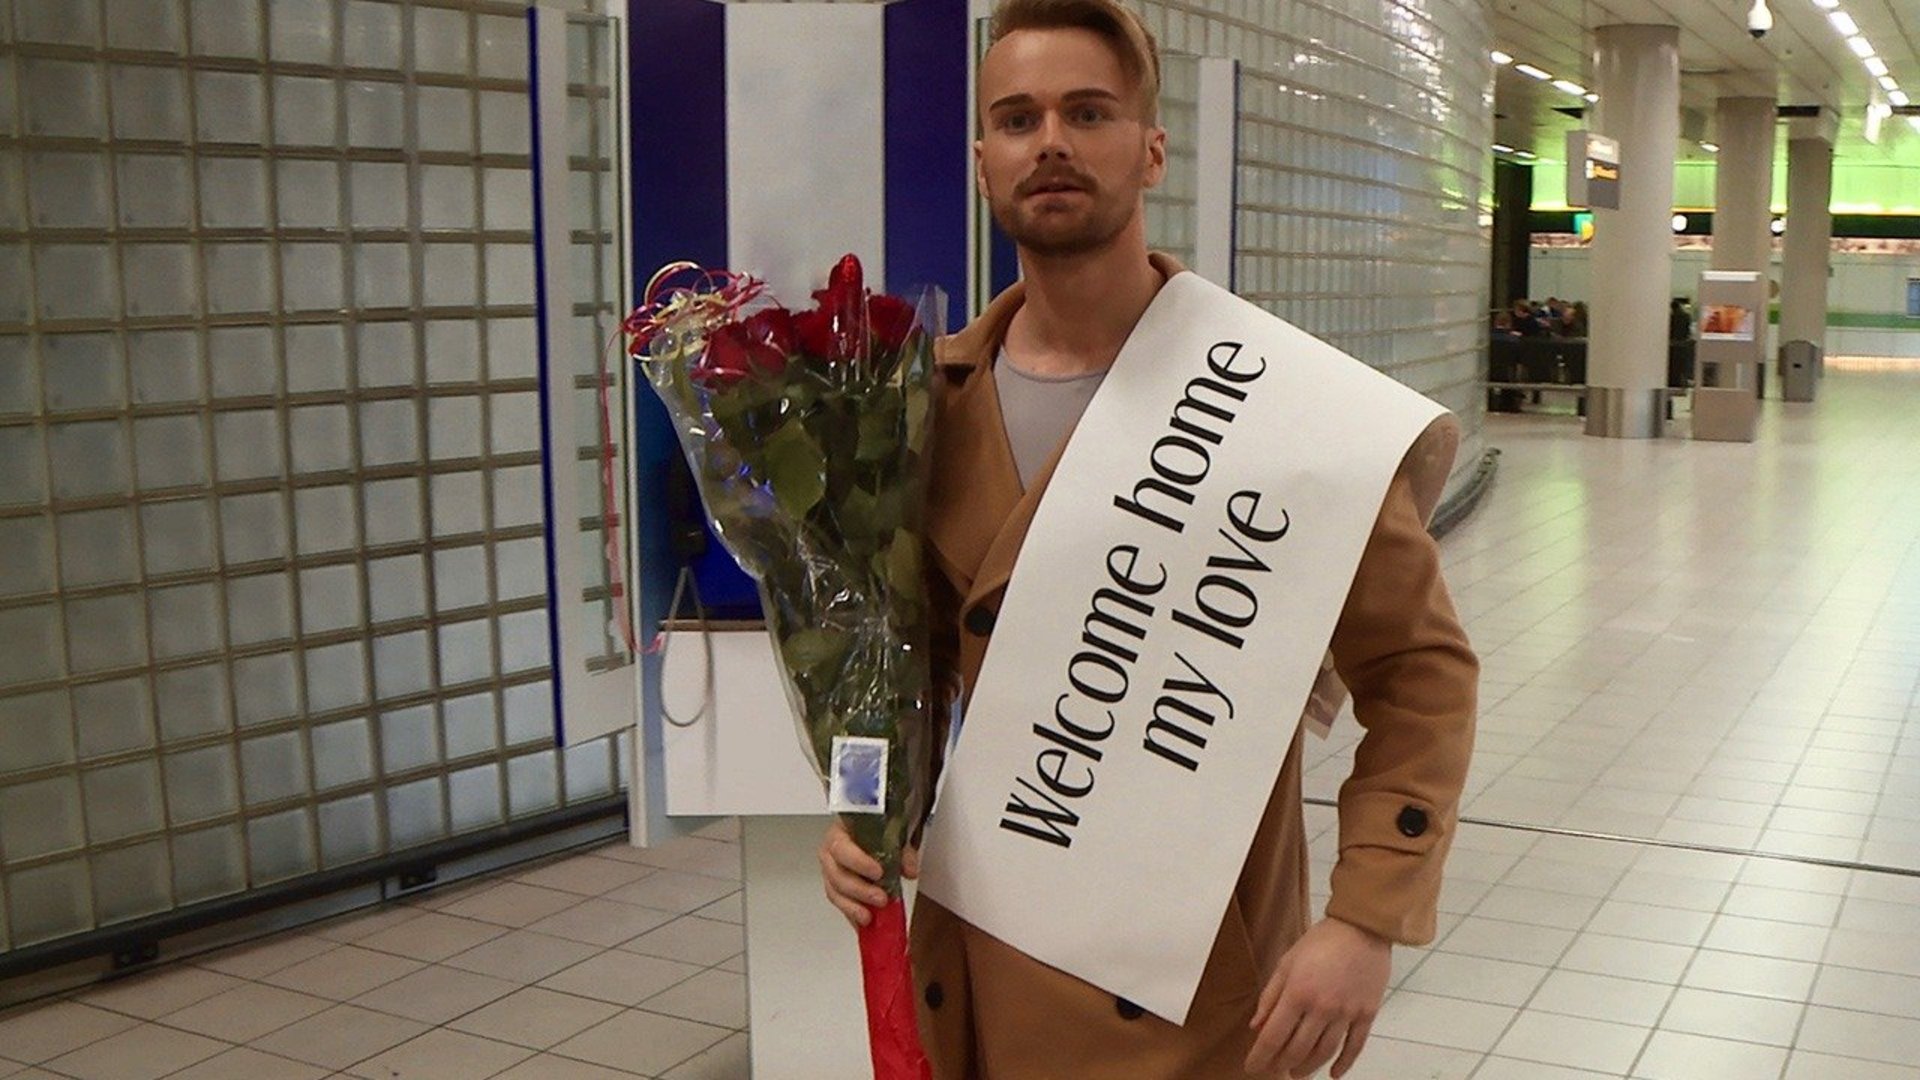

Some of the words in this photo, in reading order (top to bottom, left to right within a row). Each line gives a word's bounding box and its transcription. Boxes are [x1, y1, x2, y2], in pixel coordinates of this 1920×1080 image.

[999, 543, 1168, 849] Welcome
[1113, 340, 1267, 534] home
[1171, 489, 1290, 650] love
[1142, 651, 1234, 772] my
